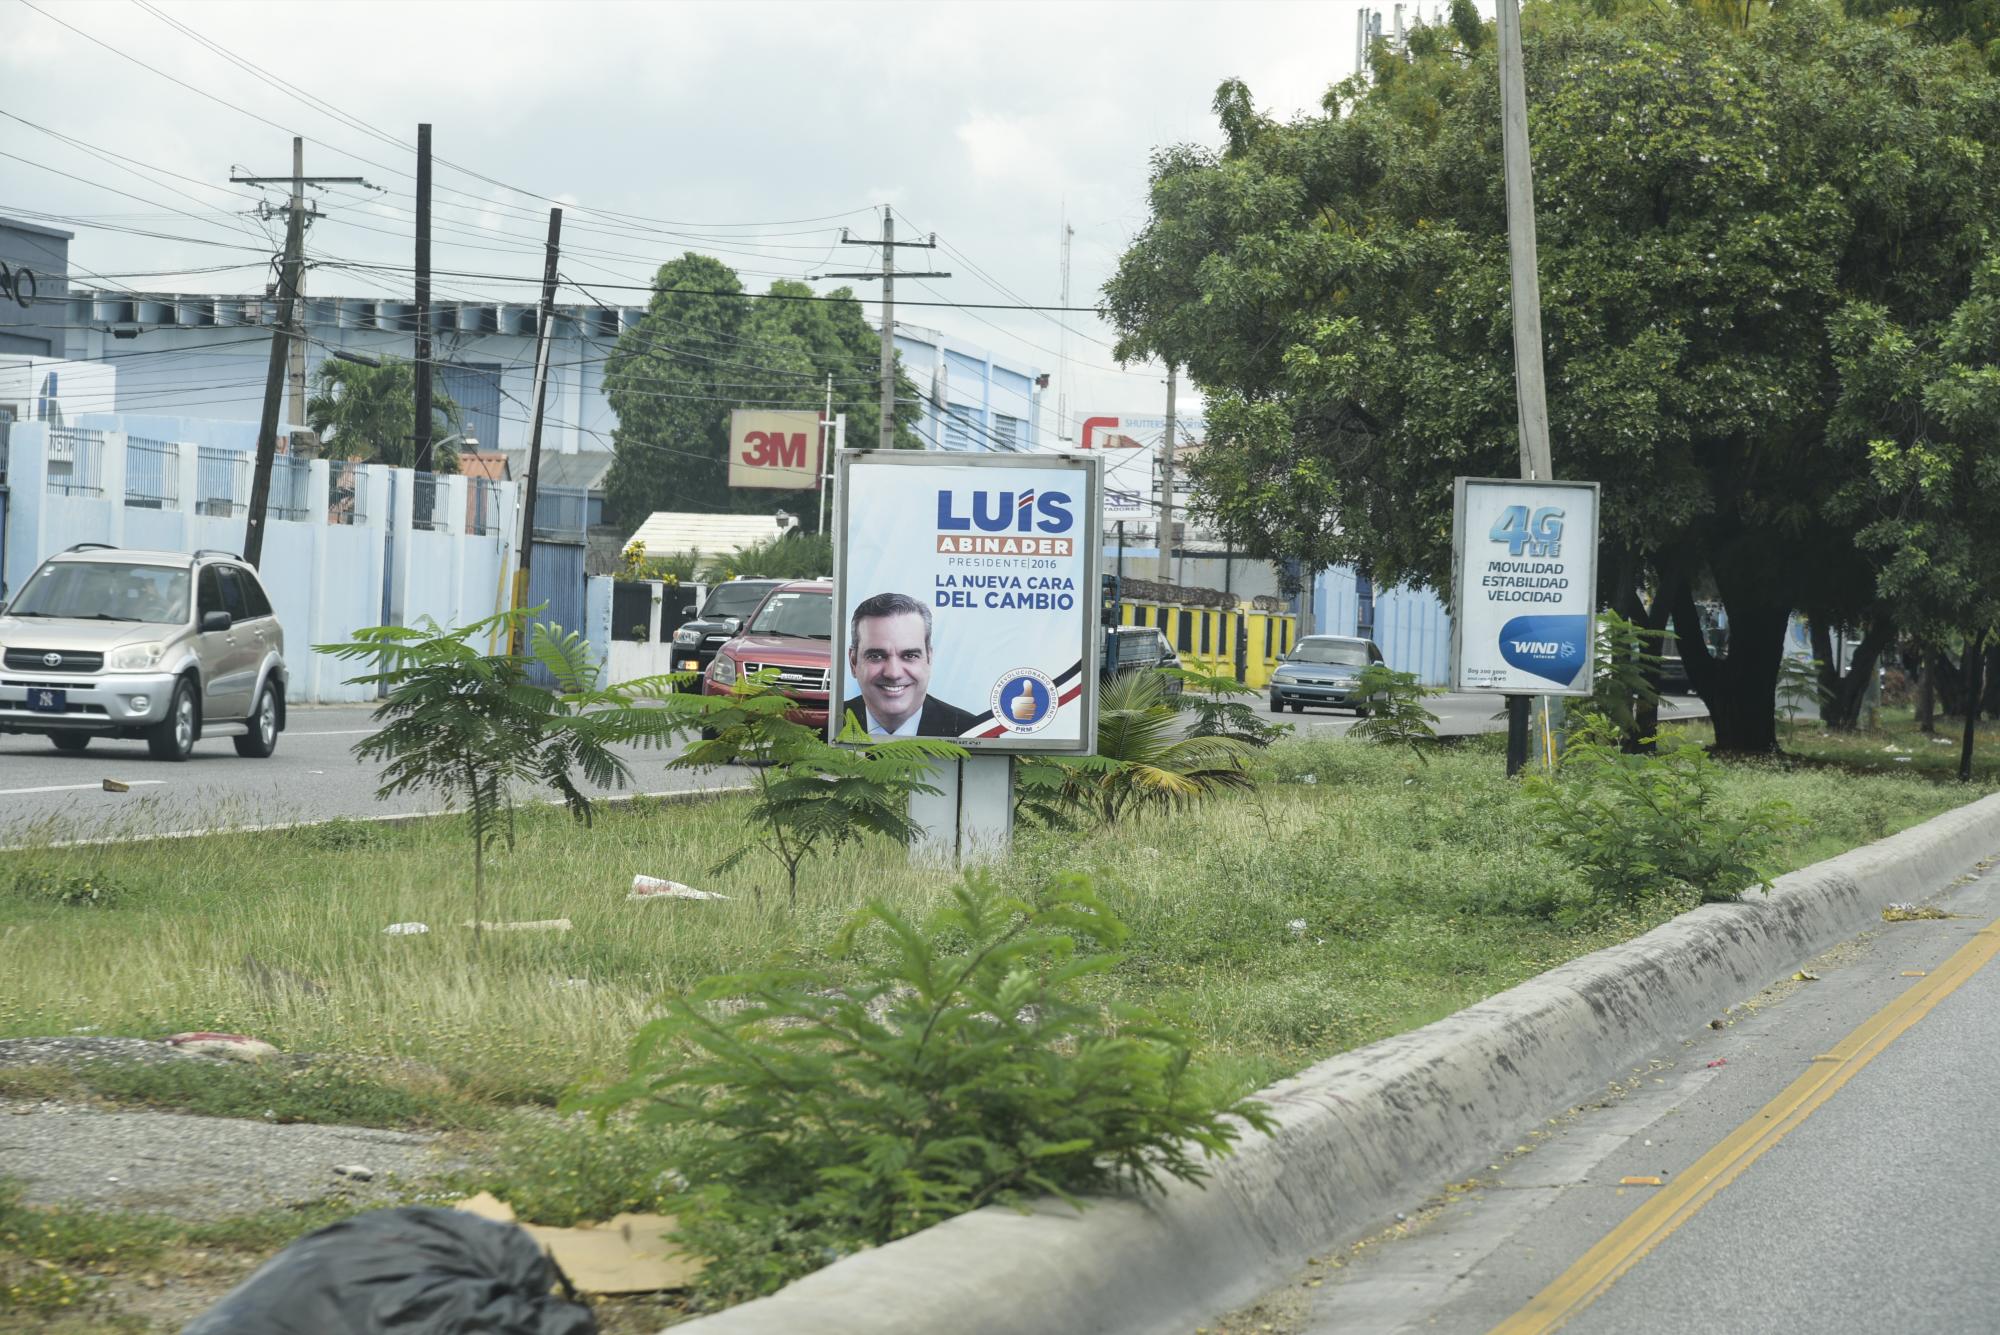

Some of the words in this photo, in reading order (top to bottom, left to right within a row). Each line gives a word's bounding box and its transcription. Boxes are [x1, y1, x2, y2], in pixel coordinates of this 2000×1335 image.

[742, 431, 807, 468] 3M
[1489, 505, 1565, 557] 4G
[939, 536, 1070, 555] ABINADER
[948, 557, 1028, 568] PRESIDENTE
[1031, 559, 1057, 569] 2016
[1487, 561, 1564, 575] MOVILIDAD
[935, 574, 957, 587] LA
[962, 575, 1021, 589] NUEVA
[1027, 576, 1075, 591] CARA
[1482, 575, 1569, 589] ESTABILIDAD
[935, 590, 978, 608] DEL
[984, 591, 1074, 611] CAMBIO
[1487, 590, 1563, 603] VELOCIDAD
[1510, 640, 1559, 654] WIND
